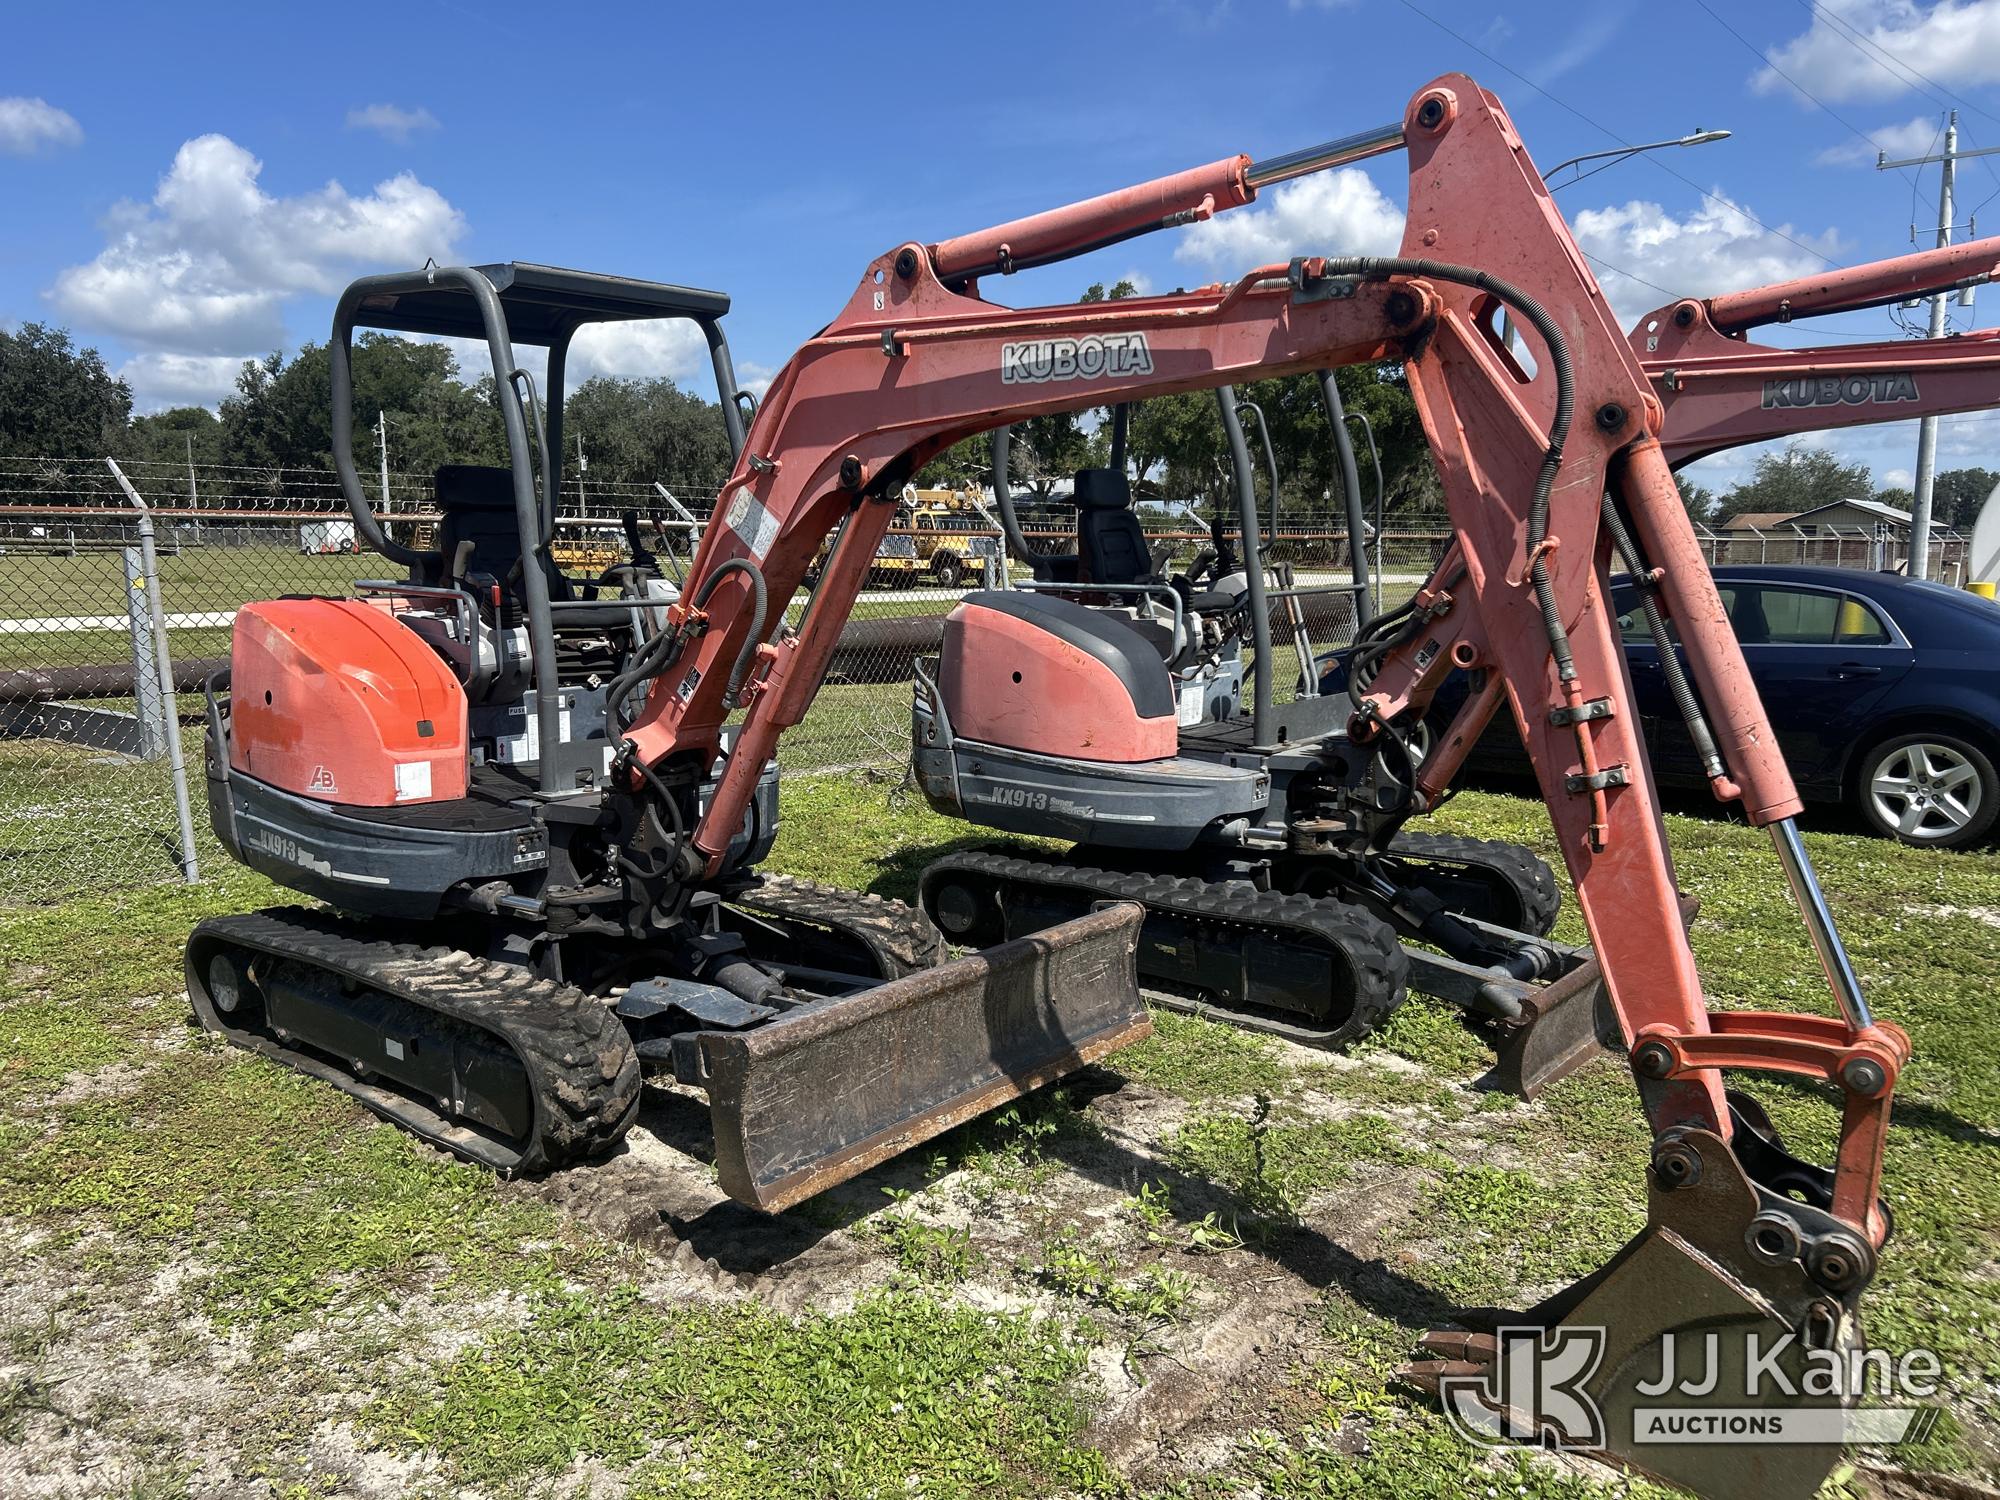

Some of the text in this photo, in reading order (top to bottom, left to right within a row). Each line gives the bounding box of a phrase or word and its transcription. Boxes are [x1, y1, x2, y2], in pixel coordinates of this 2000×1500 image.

[1003, 333, 1152, 382] KUBOTA
[1762, 371, 1919, 408] KUBOTA
[991, 787, 1047, 810] KX91-3
